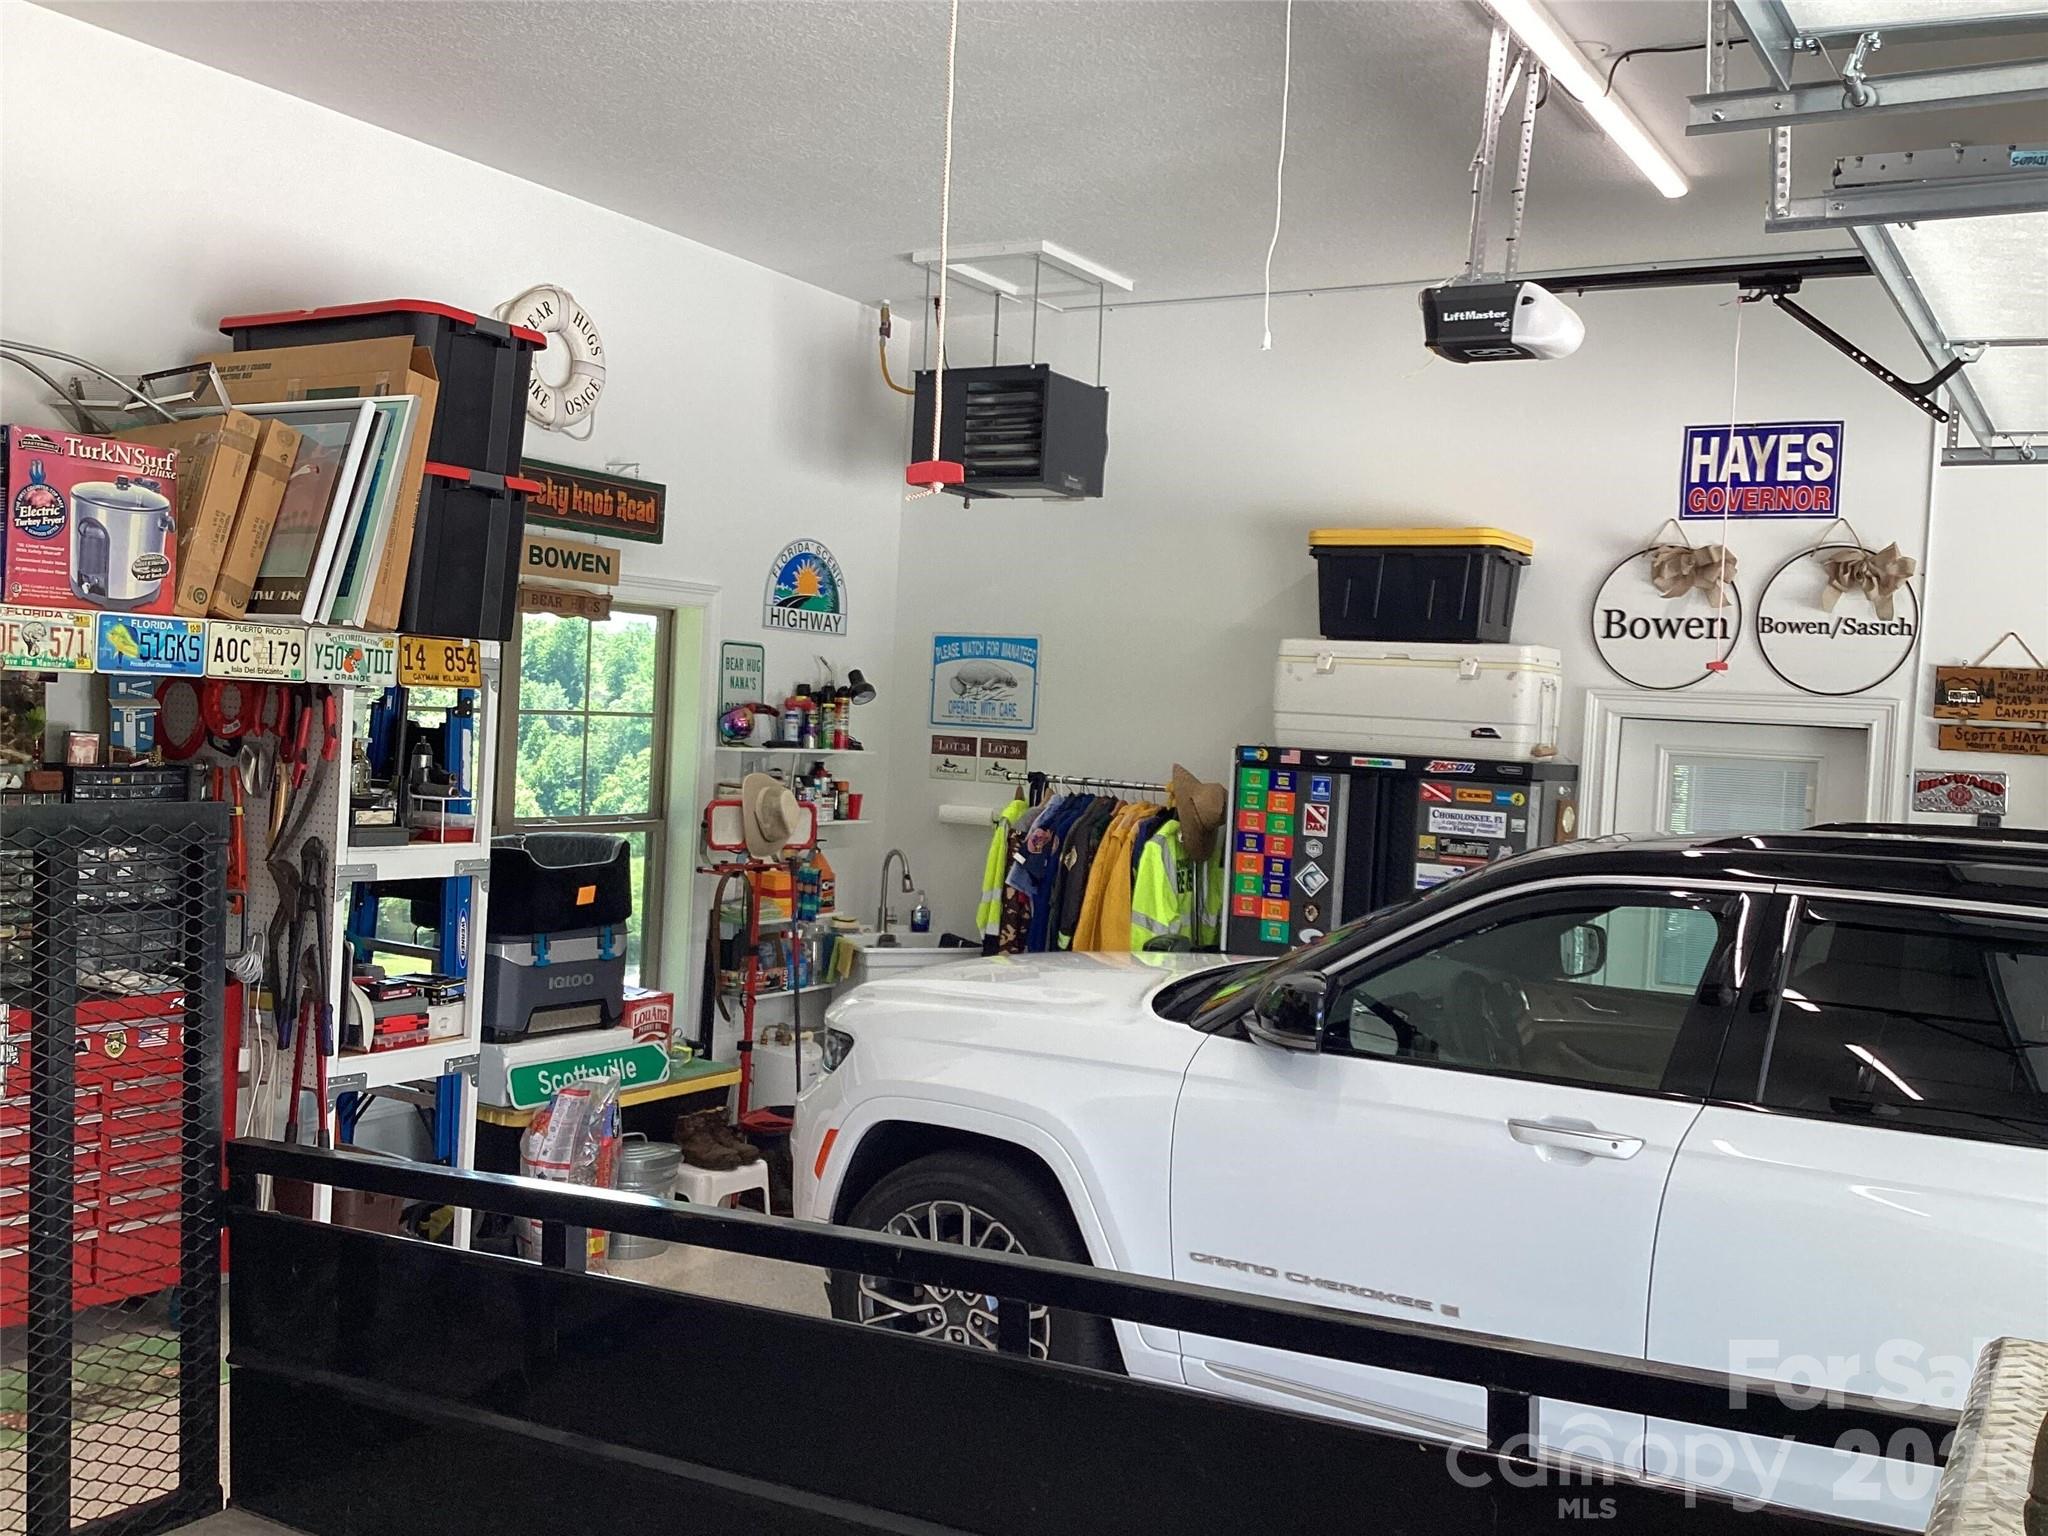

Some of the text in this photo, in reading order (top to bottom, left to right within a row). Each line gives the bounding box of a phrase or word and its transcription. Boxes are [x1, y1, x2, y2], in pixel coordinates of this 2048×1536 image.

[1443, 310, 1508, 322] LiftMaster
[573, 311, 602, 357] HUGS
[528, 376, 601, 416] AKE OSAGE
[1690, 432, 1834, 483] HAYES
[140, 464, 177, 480] Deluxe
[524, 476, 570, 515] cky
[616, 490, 656, 524] Road
[1688, 486, 1831, 512] GOVERNOR
[19, 504, 60, 518] Electric
[14, 515, 65, 527] Turkey Fryer!
[528, 544, 611, 576] BOWEN
[772, 542, 843, 588] FLORIDA SCENIC
[531, 593, 562, 609] BEAR
[6, 607, 63, 619] FLORIDA
[770, 607, 842, 633] HIGHWAY
[130, 619, 174, 631] FLORIDA
[234, 624, 283, 636] PUERTO RICO
[1600, 608, 1731, 640] Bowen
[1759, 616, 1915, 639] Bowen/Sasich
[50, 626, 85, 658] 571
[140, 632, 200, 663] 51GKS
[268, 640, 301, 666] 179
[404, 643, 477, 674] 14 854
[936, 640, 1036, 664] PLEASE WATCH FOR MANATEES
[365, 648, 393, 675] TDI
[725, 656, 761, 673] BEAR HUG
[231, 665, 284, 675] Isla Del Encanto
[334, 673, 372, 683] ORANGE
[412, 673, 470, 683] CAYMAN ISLANDS
[730, 675, 757, 690] NANA'S
[1996, 693, 2032, 706] STAYS
[948, 699, 1017, 717] OPERATE WITH CARE
[1954, 727, 1997, 743] SCOTT
[939, 739, 960, 752] LOT
[988, 742, 1009, 754] LOT
[1430, 761, 1475, 772] AMSOIL
[1306, 823, 1326, 832] DAN
[1494, 816, 1504, 824] FL
[548, 973, 594, 989] IGLOO
[1189, 1251, 1279, 1278] GRAND
[1284, 1271, 1434, 1312] CHEROKEE
